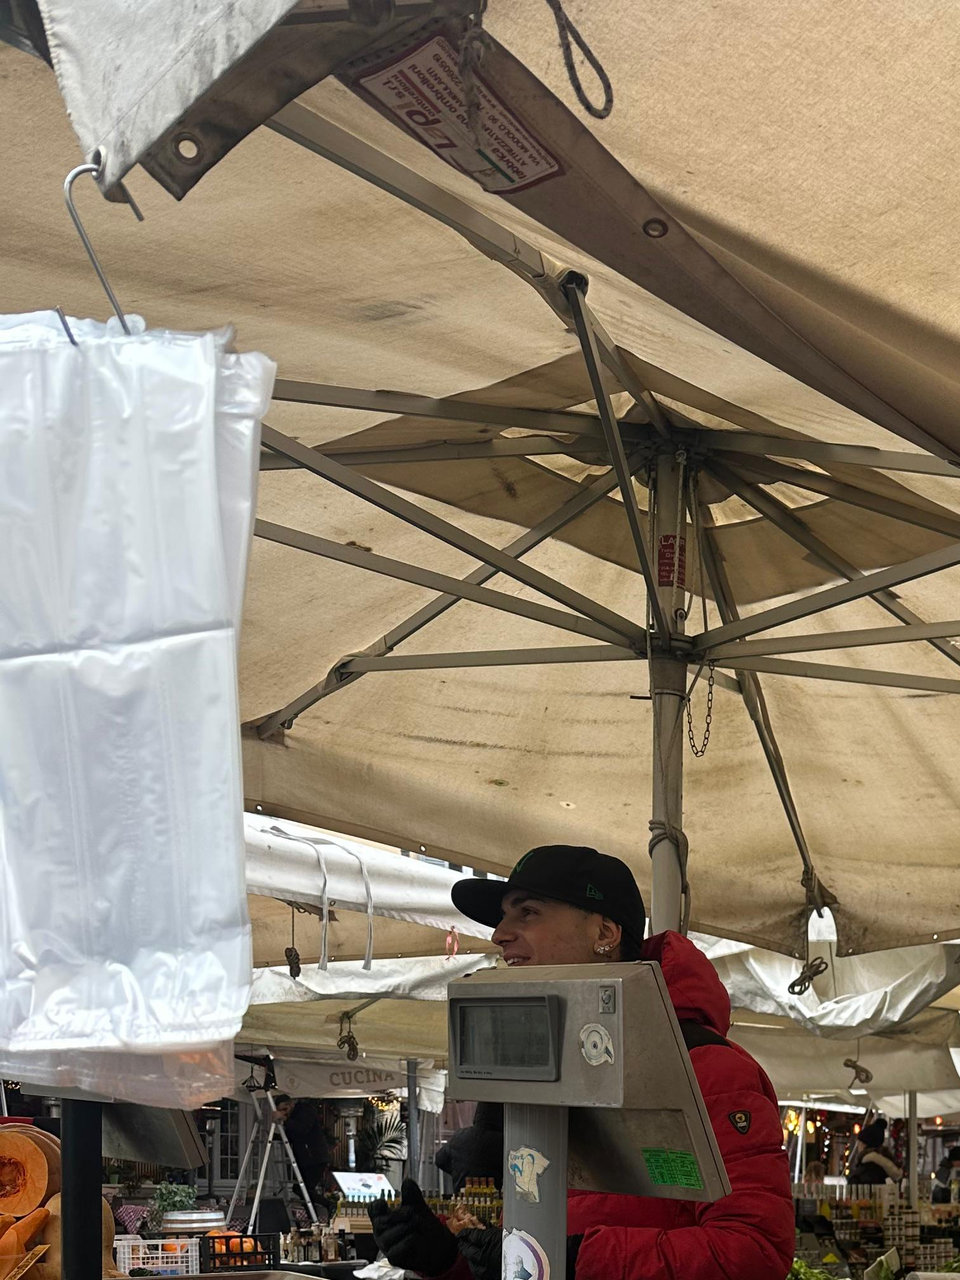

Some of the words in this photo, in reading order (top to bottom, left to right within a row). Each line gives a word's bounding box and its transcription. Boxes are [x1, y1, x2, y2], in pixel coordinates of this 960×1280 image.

[408, 63, 458, 115] ombrelloni
[491, 147, 527, 180] fabbrica
[329, 1069, 395, 1087] CUCINA
